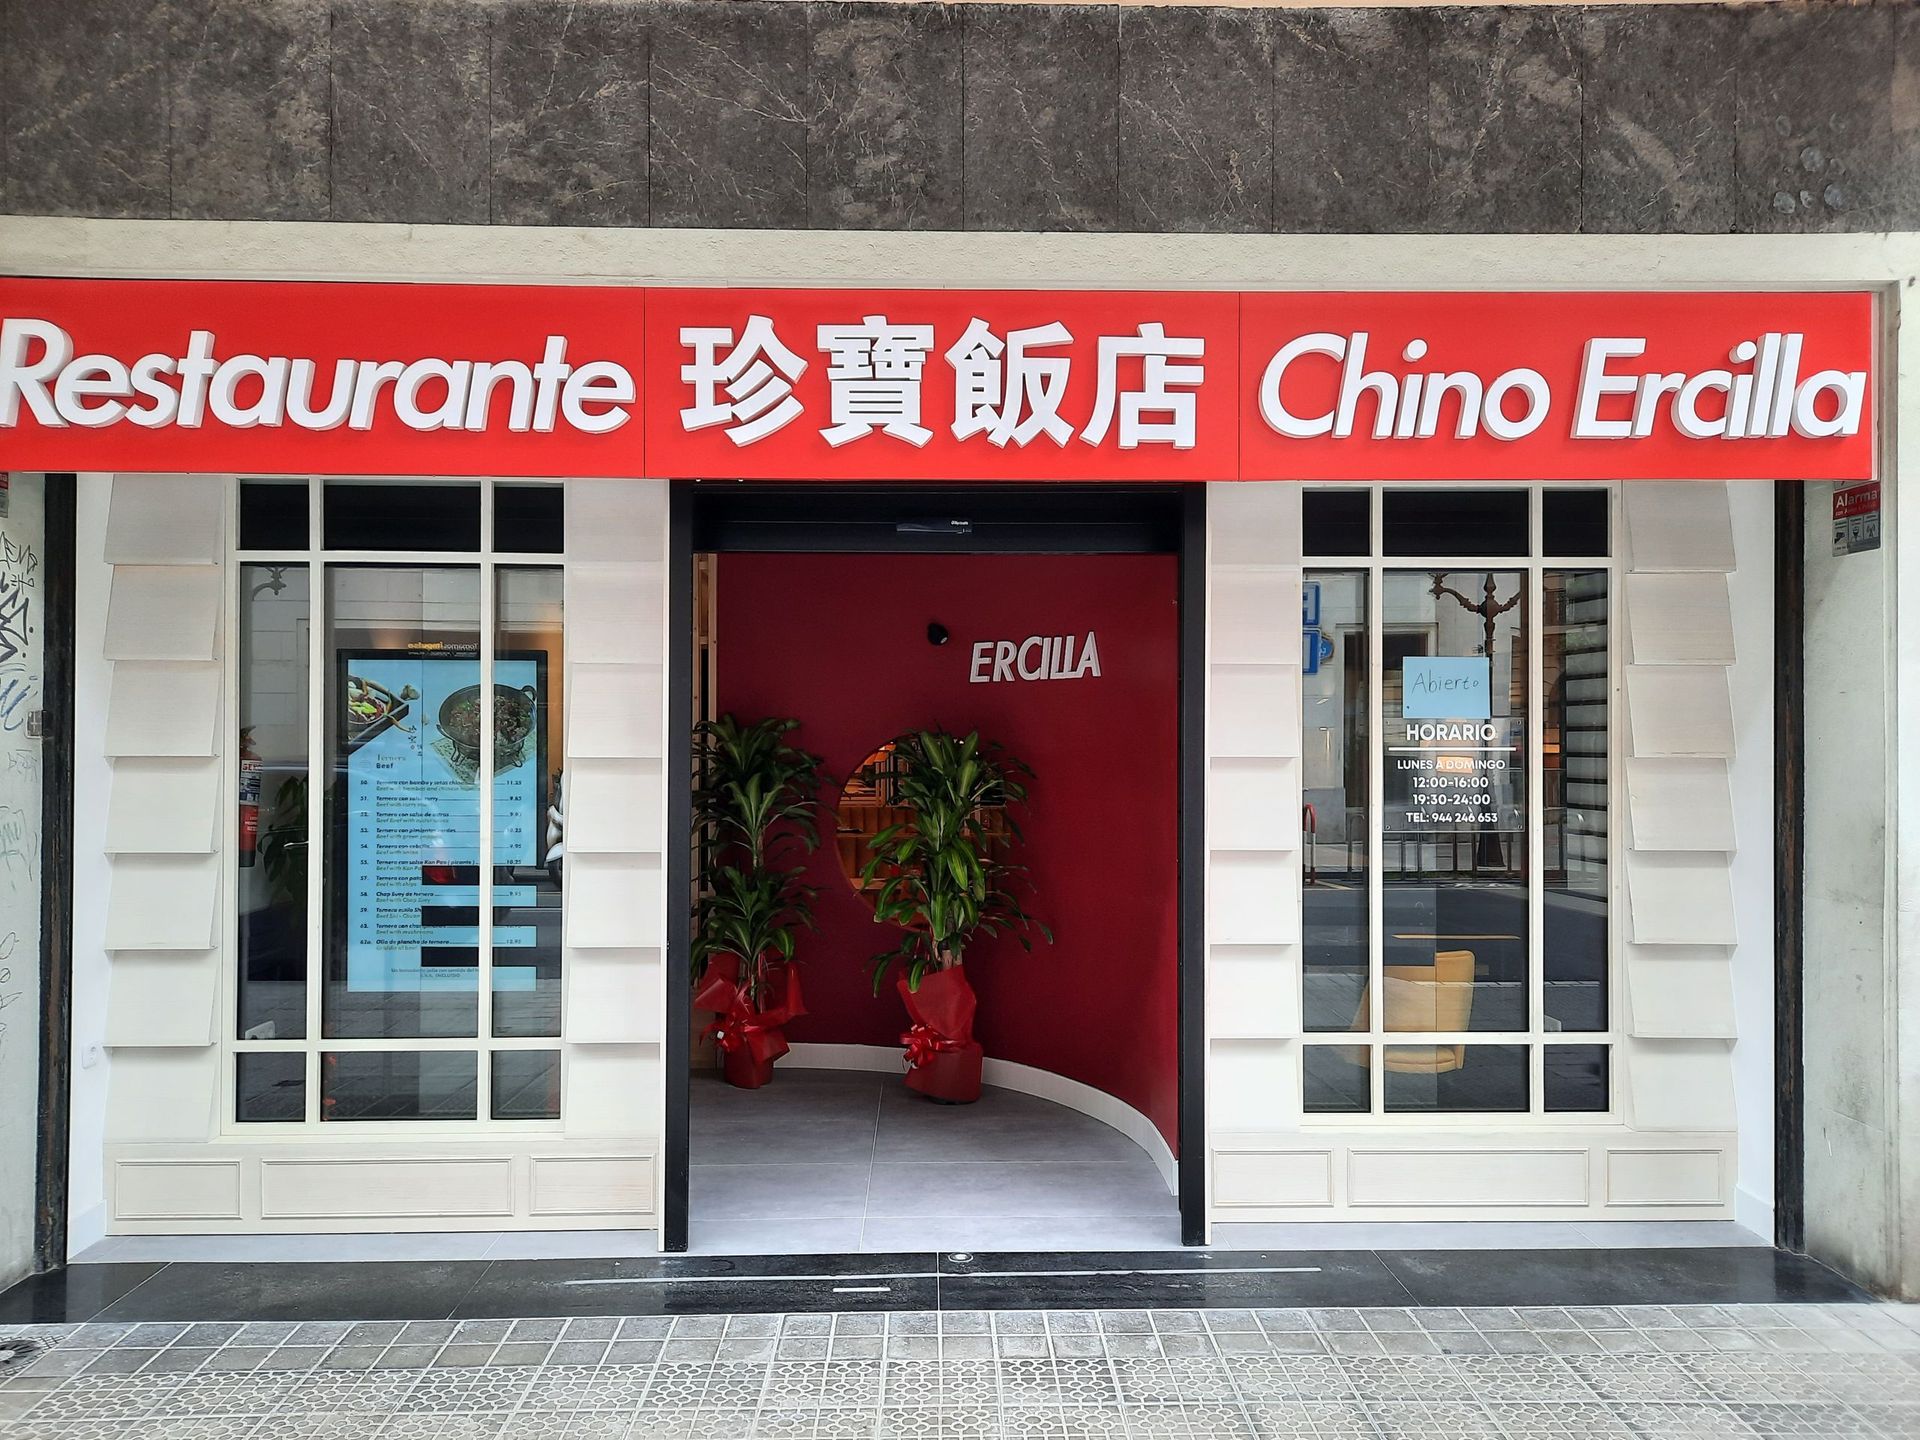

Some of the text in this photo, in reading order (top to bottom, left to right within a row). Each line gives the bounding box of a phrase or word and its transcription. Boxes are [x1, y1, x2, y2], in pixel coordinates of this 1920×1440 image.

[0, 318, 636, 432] Restaurante
[679, 314, 1206, 450] 珍寶飯店
[1259, 331, 1867, 440] Chino Ercilla
[969, 631, 1101, 683] ERCILLA
[1412, 669, 1479, 695] Abierto
[1406, 724, 1497, 741] HORARIO
[1397, 760, 1505, 770] LUNES A DOMINGO
[1412, 777, 1489, 788] 12:00-16:00
[1412, 794, 1491, 805] 19:30-24:00
[1406, 812, 1498, 823] TEL: 944 246 653
